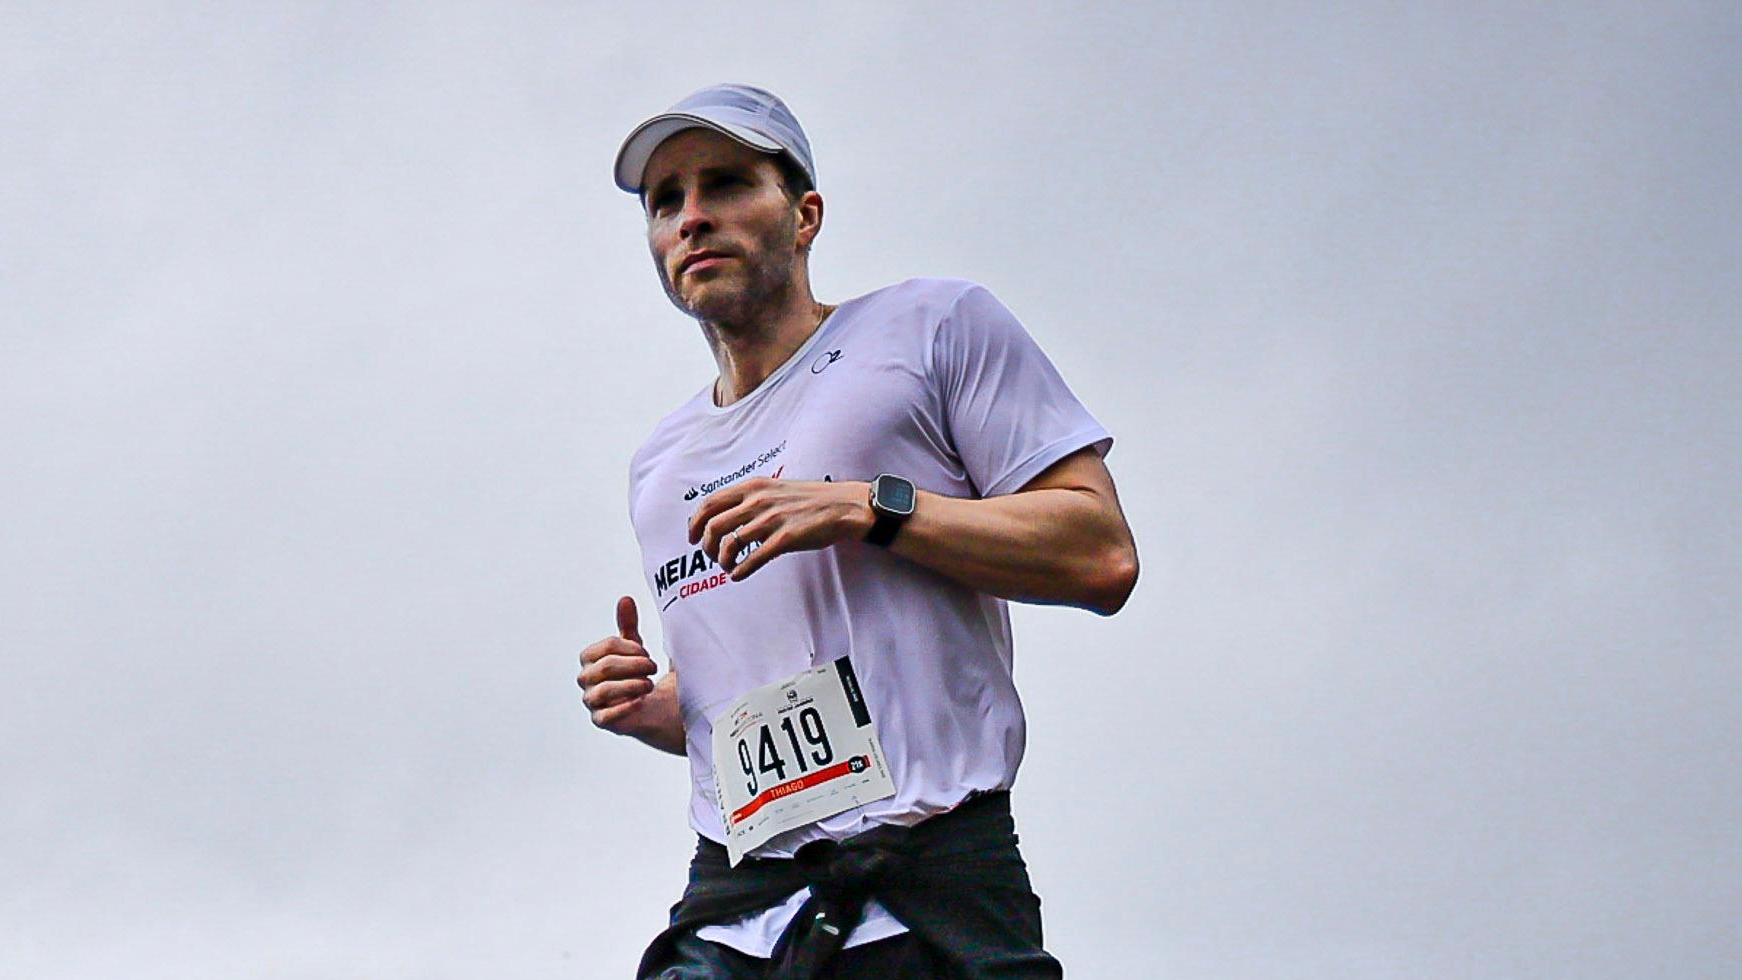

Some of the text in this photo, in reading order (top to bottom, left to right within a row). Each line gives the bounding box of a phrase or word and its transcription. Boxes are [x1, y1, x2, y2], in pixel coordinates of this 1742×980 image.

[700, 439, 787, 497] Santander Select
[654, 549, 707, 597] MEIA
[679, 572, 728, 599] CIDADE
[737, 706, 834, 797] 9419
[769, 780, 805, 799] THIAGO
